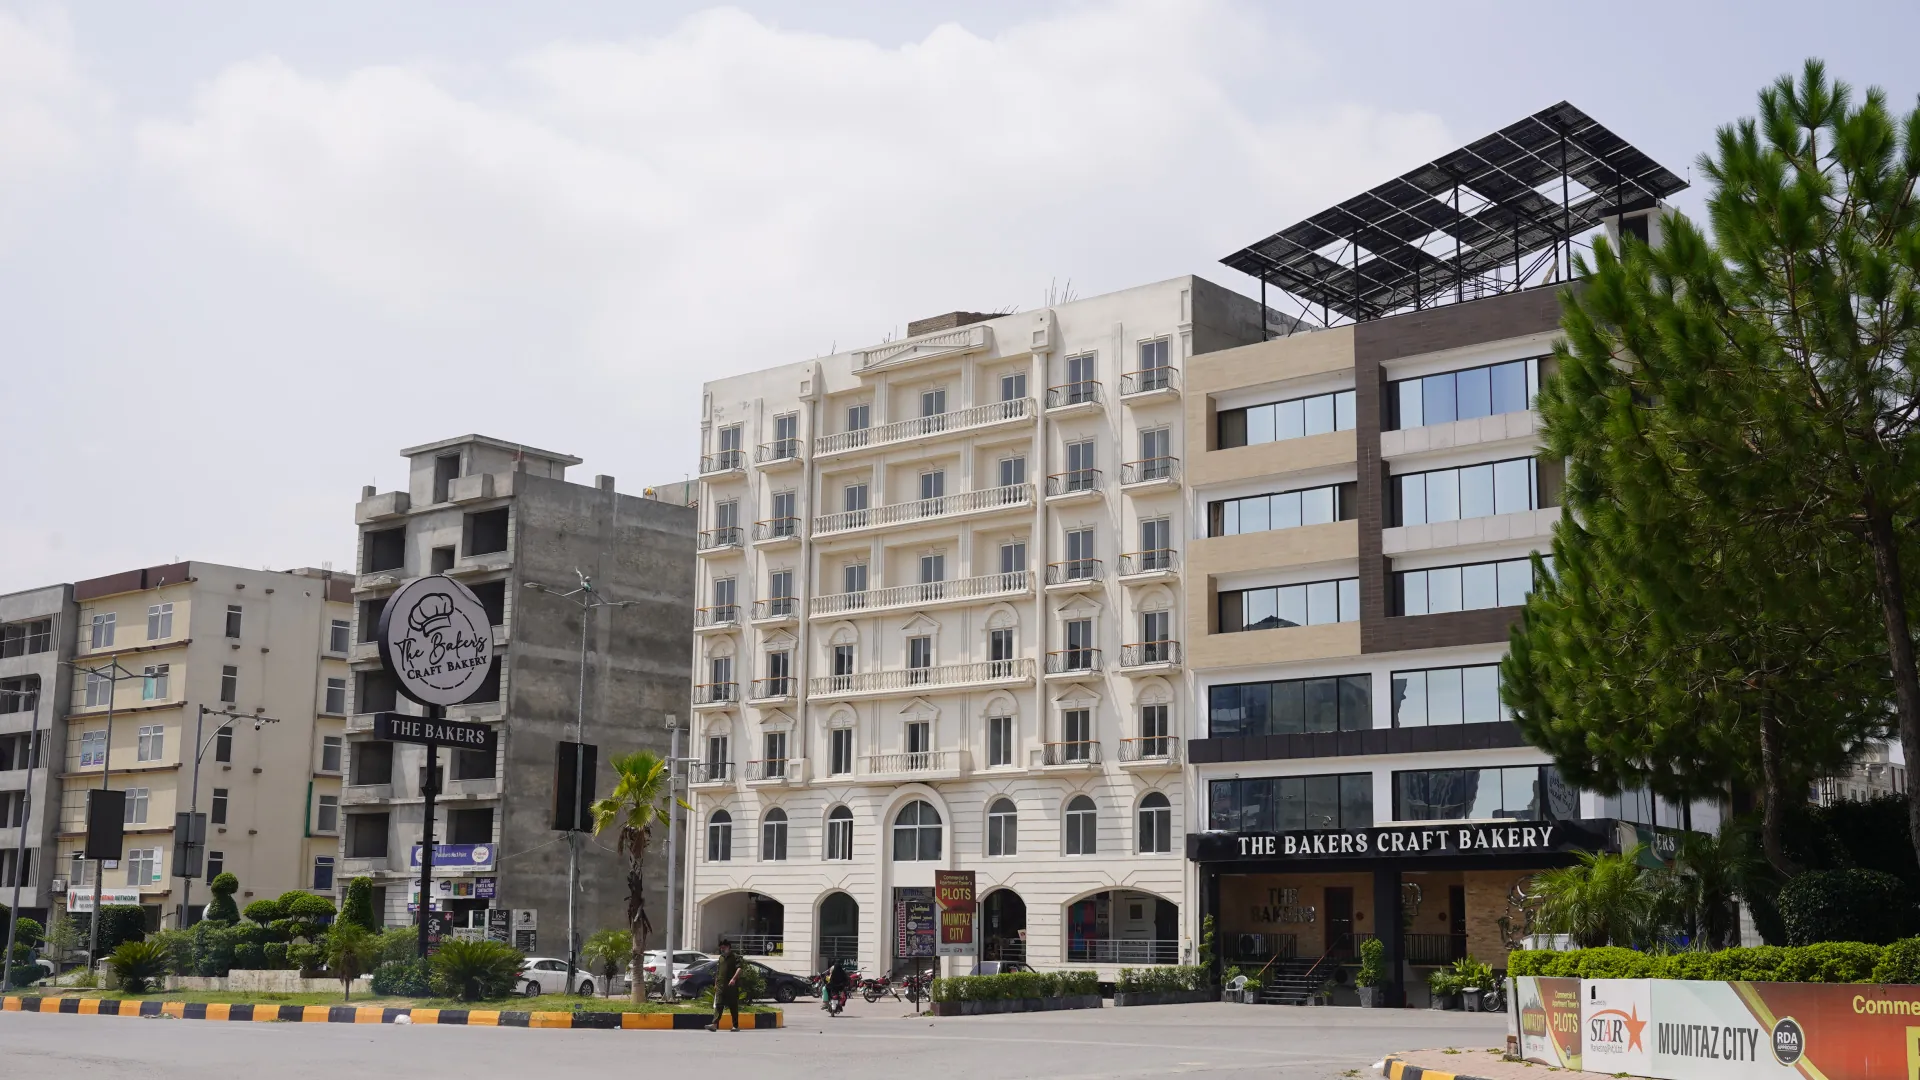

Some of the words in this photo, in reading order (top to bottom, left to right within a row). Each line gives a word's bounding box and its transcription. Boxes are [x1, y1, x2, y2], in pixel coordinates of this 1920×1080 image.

[394, 637, 424, 672] The
[407, 665, 442, 680] CRAFT
[448, 656, 488, 672] BAKERY
[391, 719, 421, 737] THE
[425, 723, 485, 744] BAKERS
[1238, 836, 1276, 855] THE
[1284, 833, 1368, 854] BAKERS
[1377, 830, 1450, 852] CRAFT
[1459, 826, 1553, 848] BAKERY
[941, 887, 971, 900] PLOTS
[942, 912, 970, 926] MUMTAZ
[949, 927, 964, 941] CITY
[1852, 994, 1920, 1016] Comme
[1553, 1012, 1578, 1034] PLOTS
[1590, 1018, 1623, 1043] STAR
[1658, 1022, 1719, 1059] MUMTAZ
[1723, 1026, 1759, 1062] CITY
[1776, 1031, 1798, 1044] RDA
